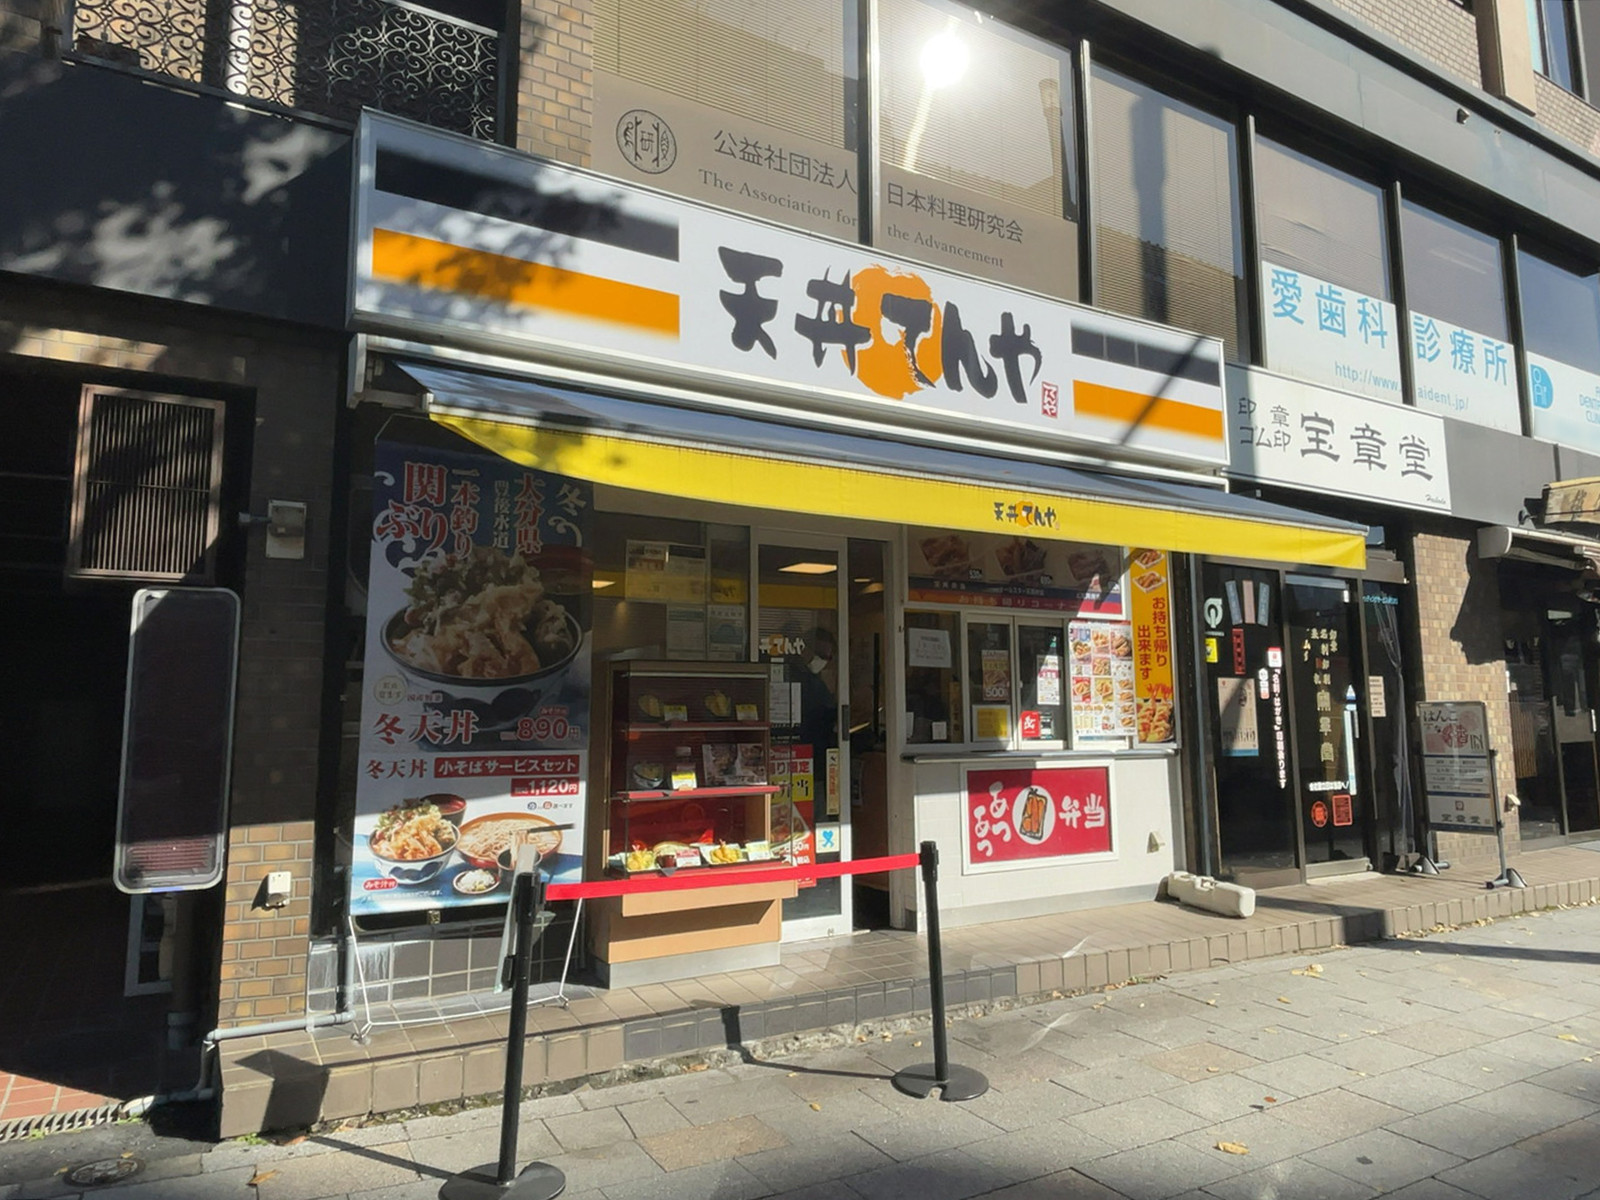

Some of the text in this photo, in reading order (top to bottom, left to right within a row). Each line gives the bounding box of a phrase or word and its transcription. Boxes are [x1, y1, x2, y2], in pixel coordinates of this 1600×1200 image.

[698, 168, 1004, 268] The Association for the Advancement
[714, 129, 1023, 243] 公益社団法人 日本料理研究会
[718, 245, 1043, 404] 天丼てんや
[1271, 268, 1389, 349] 愛歯科
[1413, 314, 1508, 387] 診療所
[1239, 426, 1292, 451] ゴム印
[1300, 411, 1434, 482] 宝章堂
[450, 467, 480, 559] 一本釣り
[514, 471, 545, 555] 大分県
[556, 482, 587, 517] 冬
[1138, 625, 1152, 680] 出来ます
[1152, 597, 1168, 667] お持ち帰り
[374, 708, 480, 745] 冬天丼
[366, 758, 427, 779] 冬天丼
[438, 758, 576, 774] 小そばサービスセット
[1058, 793, 1106, 829] 弁当
